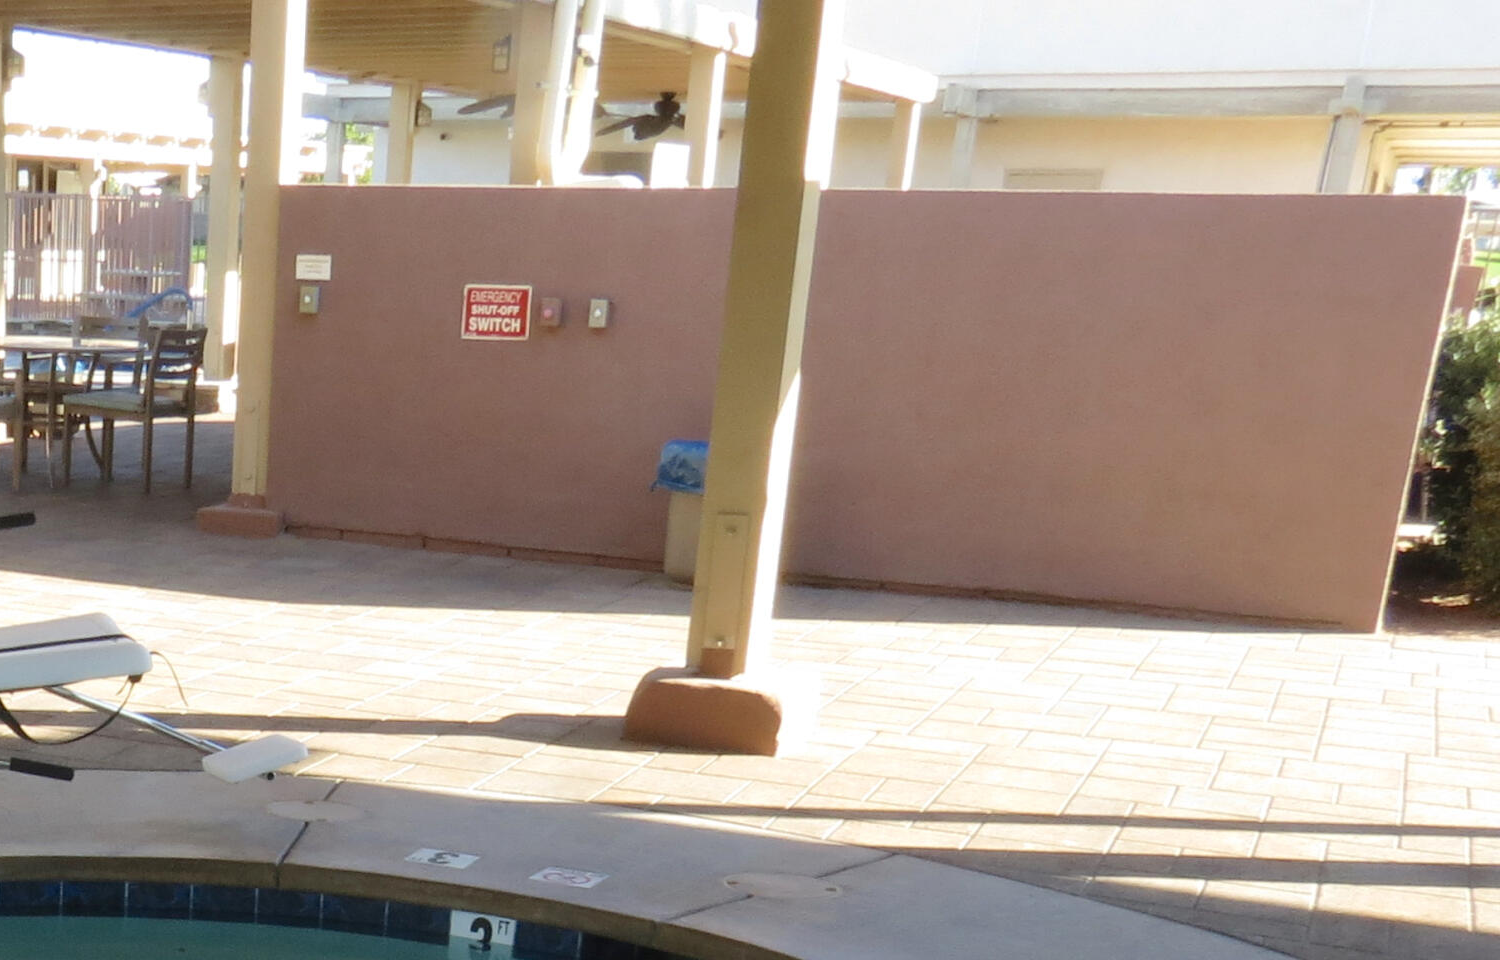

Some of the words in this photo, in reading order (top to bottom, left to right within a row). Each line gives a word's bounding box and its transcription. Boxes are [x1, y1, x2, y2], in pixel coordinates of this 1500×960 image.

[470, 290, 523, 303] EMERGENCY
[471, 304, 520, 316] SHUT-OFF
[469, 316, 521, 333] SWITCH
[497, 920, 511, 936] FT
